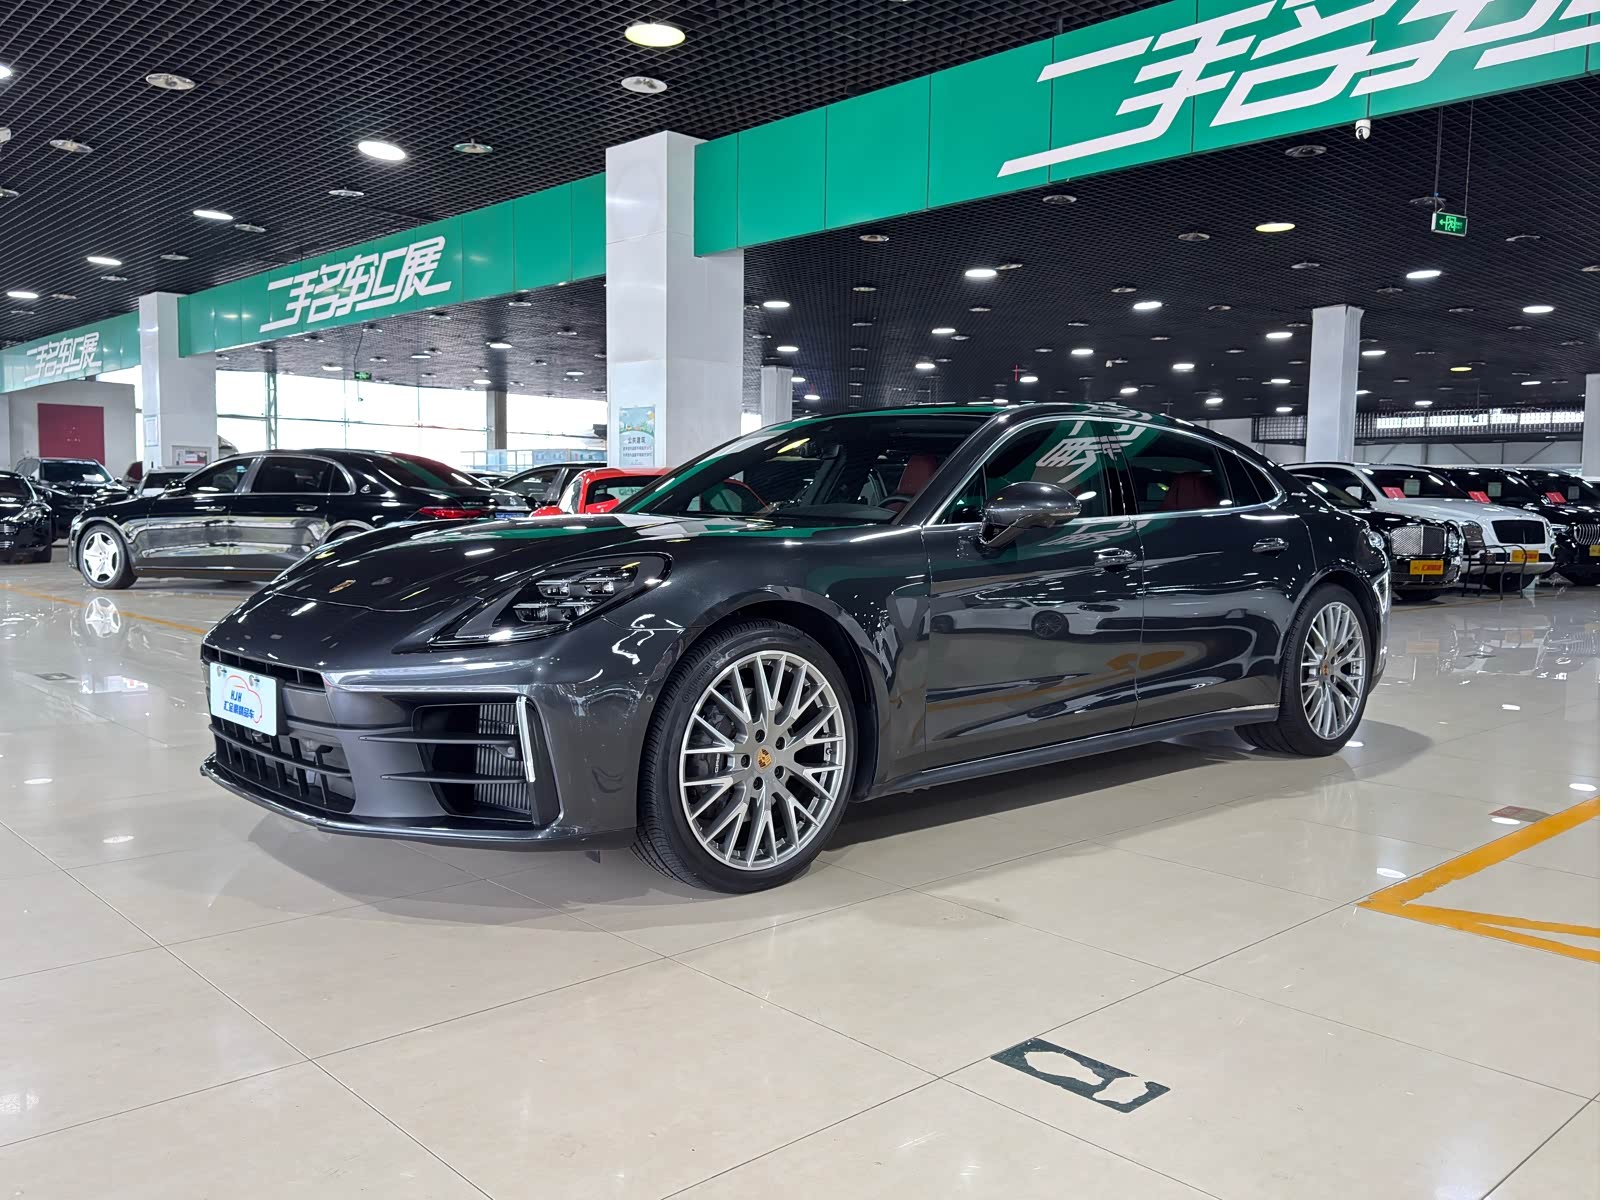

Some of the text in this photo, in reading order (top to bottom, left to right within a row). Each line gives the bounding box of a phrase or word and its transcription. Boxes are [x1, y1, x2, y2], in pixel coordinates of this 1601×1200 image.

[259, 235, 452, 334] 二手名车汇展
[24, 332, 102, 382] 二手名车汇展
